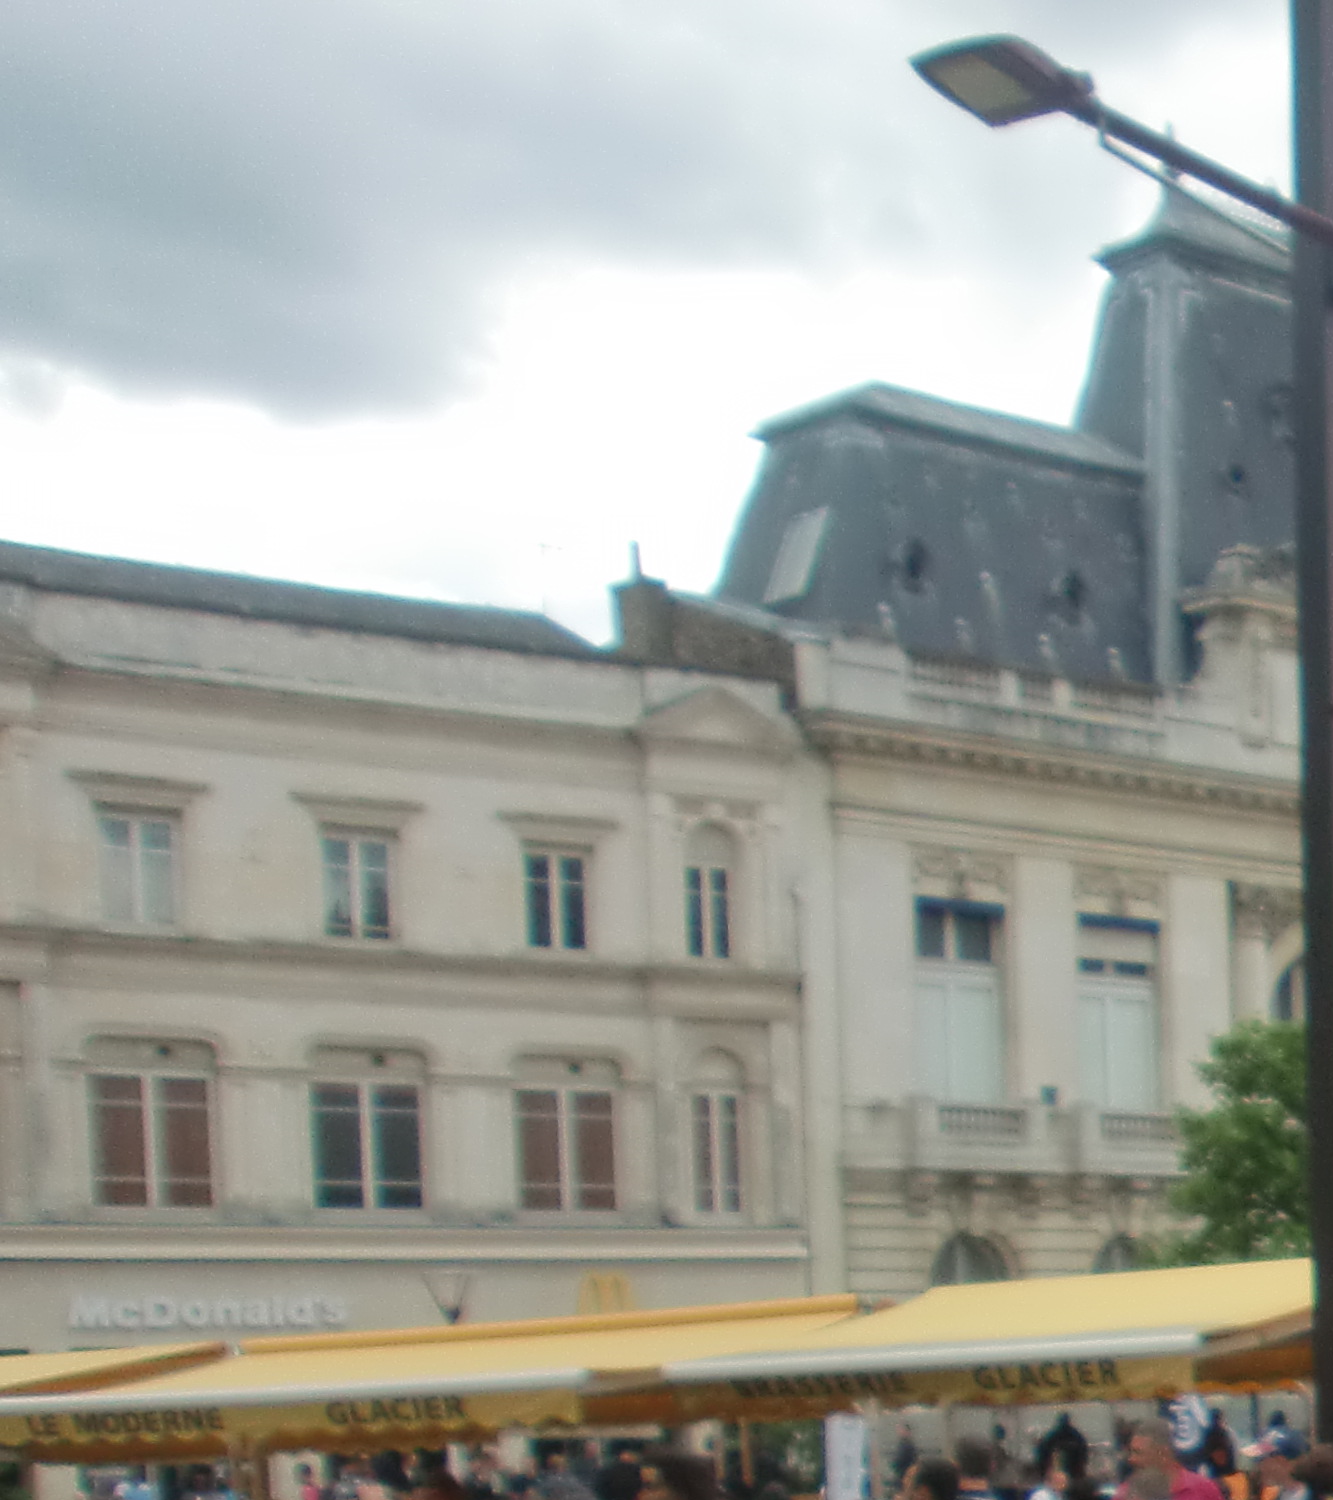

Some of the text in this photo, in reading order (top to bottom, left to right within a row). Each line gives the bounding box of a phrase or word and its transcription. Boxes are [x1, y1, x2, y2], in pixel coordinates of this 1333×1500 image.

[68, 1296, 346, 1328] McDonald's
[973, 1359, 1118, 1390] GLACIER
[27, 1405, 225, 1436] LE MODERNE
[324, 1393, 468, 1425] GLACIER
